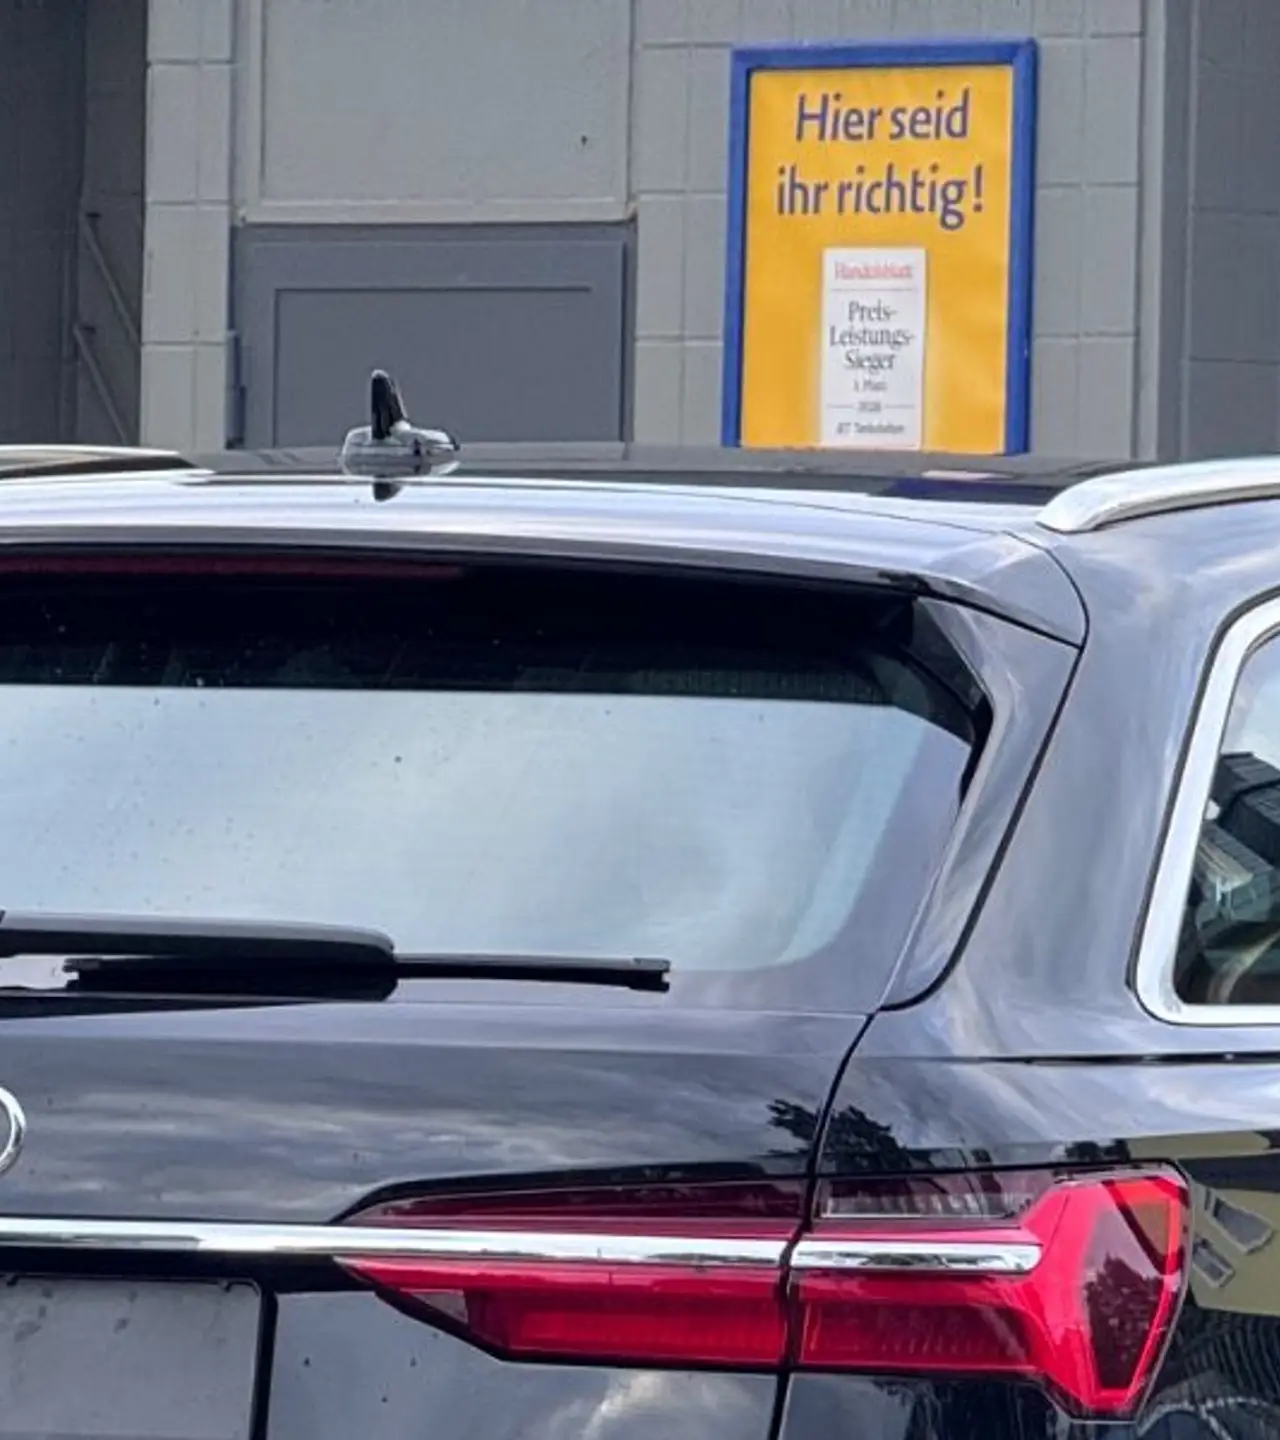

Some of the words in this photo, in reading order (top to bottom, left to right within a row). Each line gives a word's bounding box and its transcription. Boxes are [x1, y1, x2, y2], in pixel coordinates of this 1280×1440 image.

[795, 92, 883, 142] Hier
[888, 87, 971, 141] seid
[776, 163, 829, 216] ihr
[836, 162, 984, 231] richtig!
[847, 298, 899, 323] Preis-
[828, 324, 916, 351] Leistungs-
[844, 349, 896, 375] Sieger
